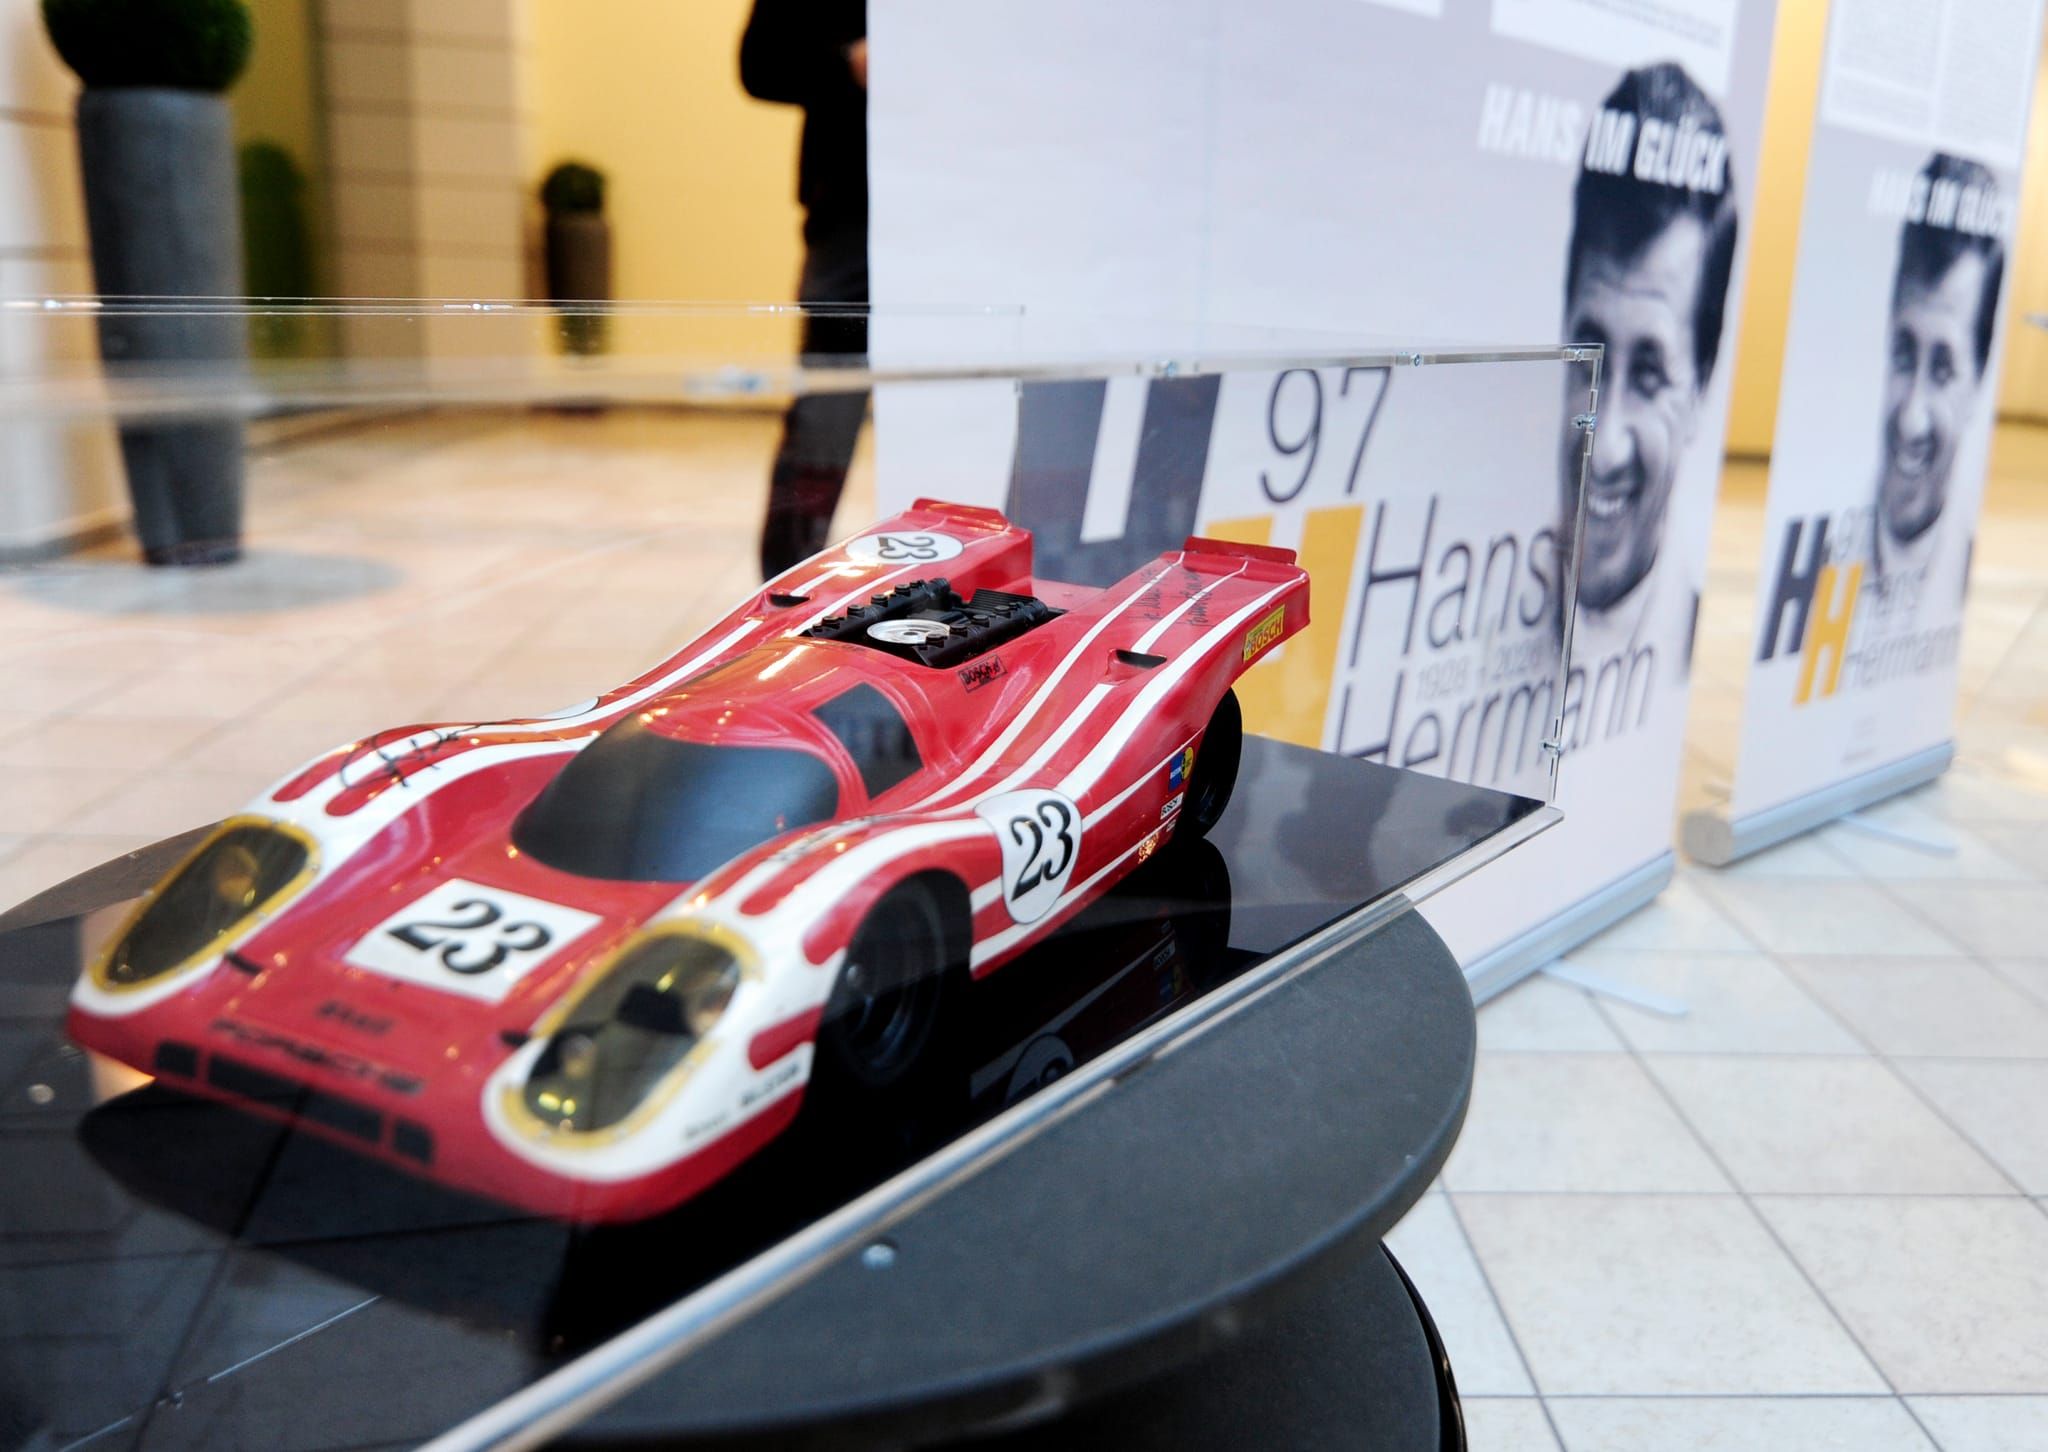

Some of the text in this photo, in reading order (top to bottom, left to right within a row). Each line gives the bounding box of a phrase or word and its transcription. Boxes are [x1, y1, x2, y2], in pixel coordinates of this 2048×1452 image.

[1477, 84, 1727, 196] HANS IM GLÜCK
[1260, 366, 1392, 504] 97
[877, 535, 939, 560] 23
[1349, 493, 1556, 668] Hans
[1250, 615, 1284, 653] BOSCH
[1335, 640, 1656, 786] Herrmann
[1009, 799, 1074, 902] 23
[386, 898, 553, 976] 23
